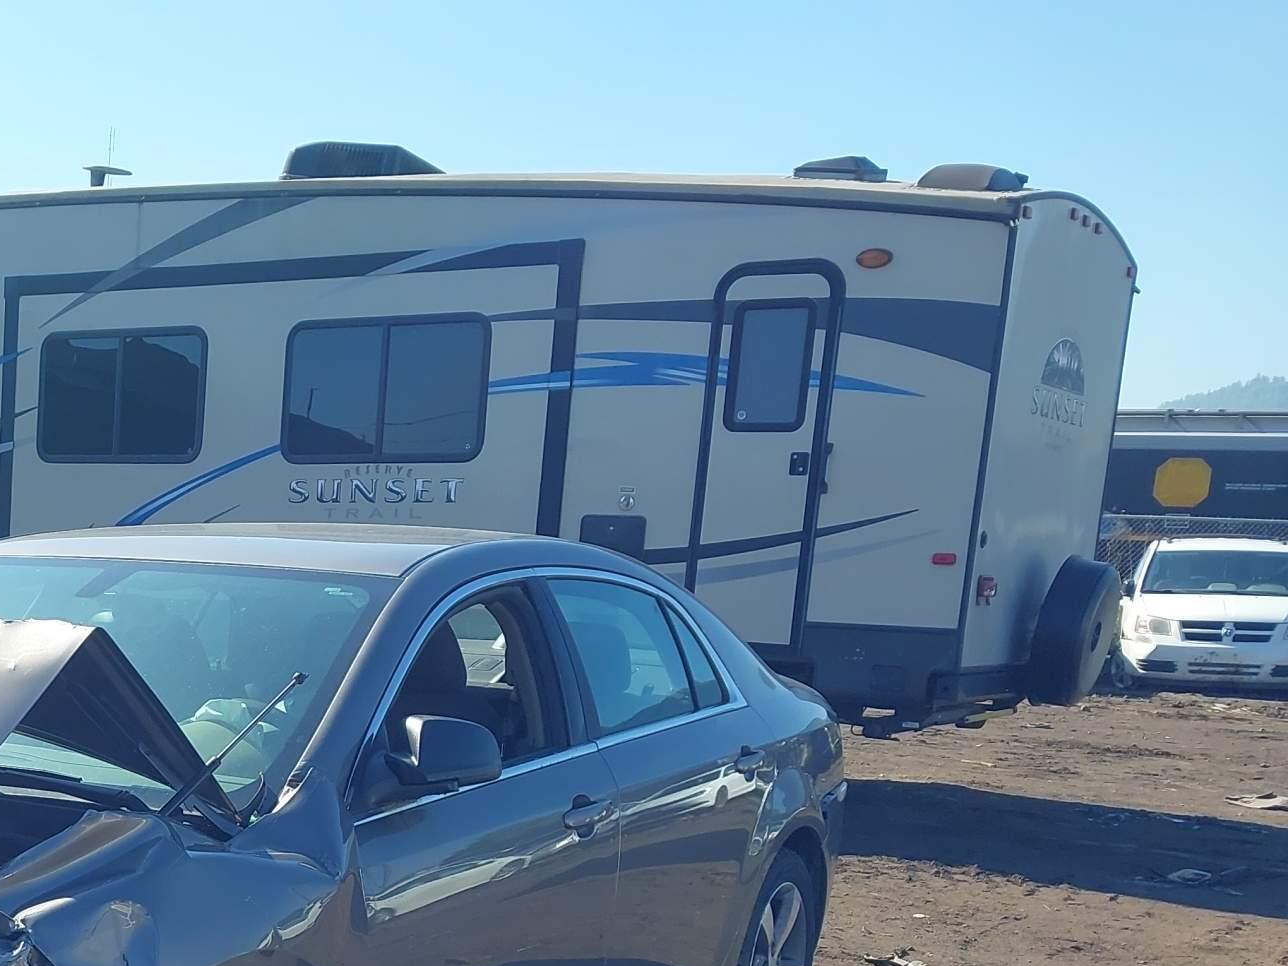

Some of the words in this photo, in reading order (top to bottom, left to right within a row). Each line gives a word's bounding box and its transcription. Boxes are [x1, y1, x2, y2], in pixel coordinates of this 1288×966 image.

[1031, 385, 1088, 428] SUNSET
[344, 464, 413, 479] RESERVE
[288, 478, 464, 504] SUNSET
[325, 507, 423, 520] TRAIL
